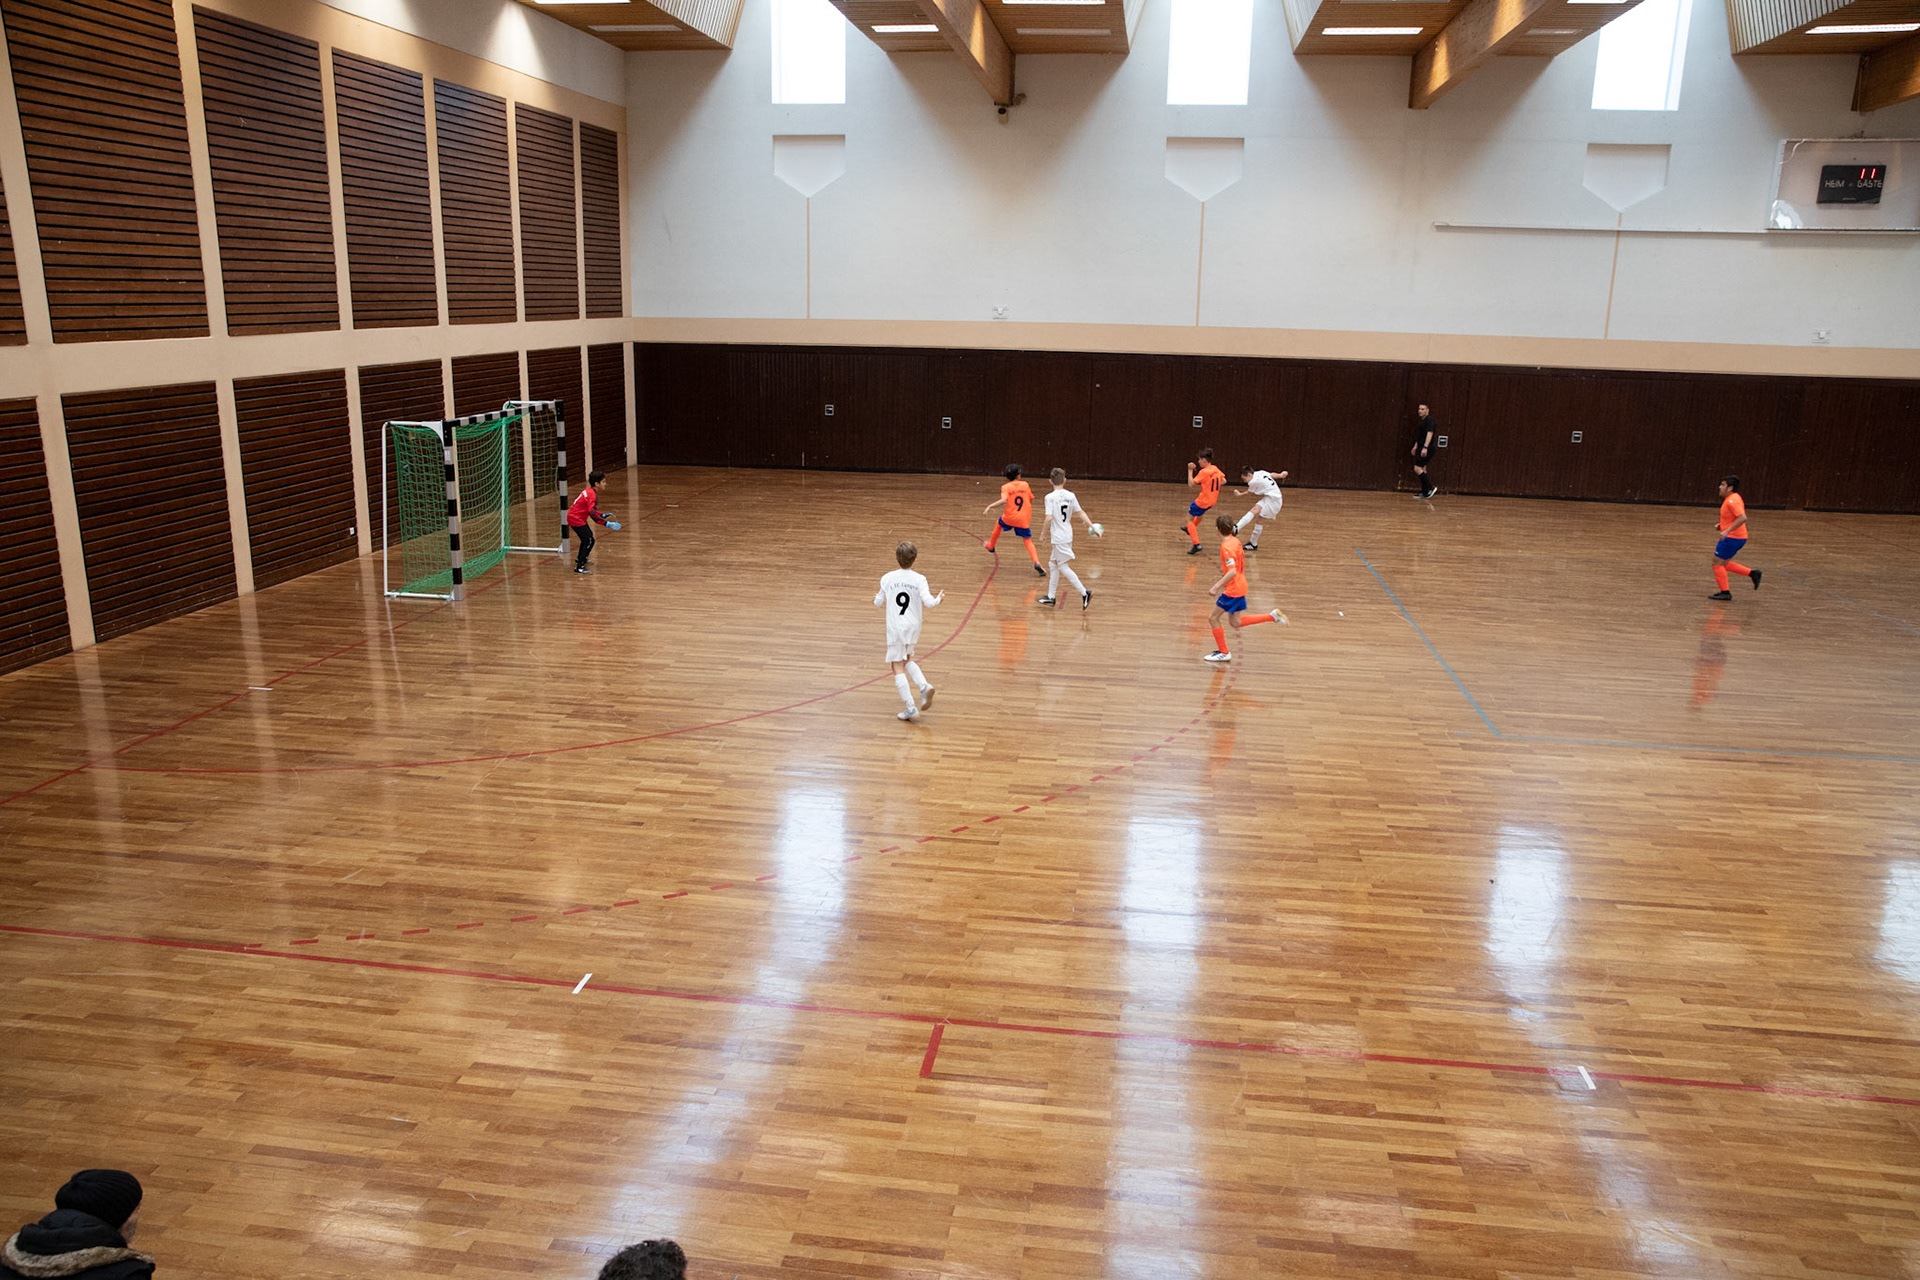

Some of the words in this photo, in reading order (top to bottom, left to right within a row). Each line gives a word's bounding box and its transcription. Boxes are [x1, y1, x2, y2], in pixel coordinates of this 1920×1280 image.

[1860, 168, 1876, 179] 11
[1824, 180, 1845, 188] HEIM
[1211, 478, 1220, 492] 11
[1014, 496, 1024, 511] 9
[1061, 504, 1068, 522] 5
[896, 592, 910, 615] 9
